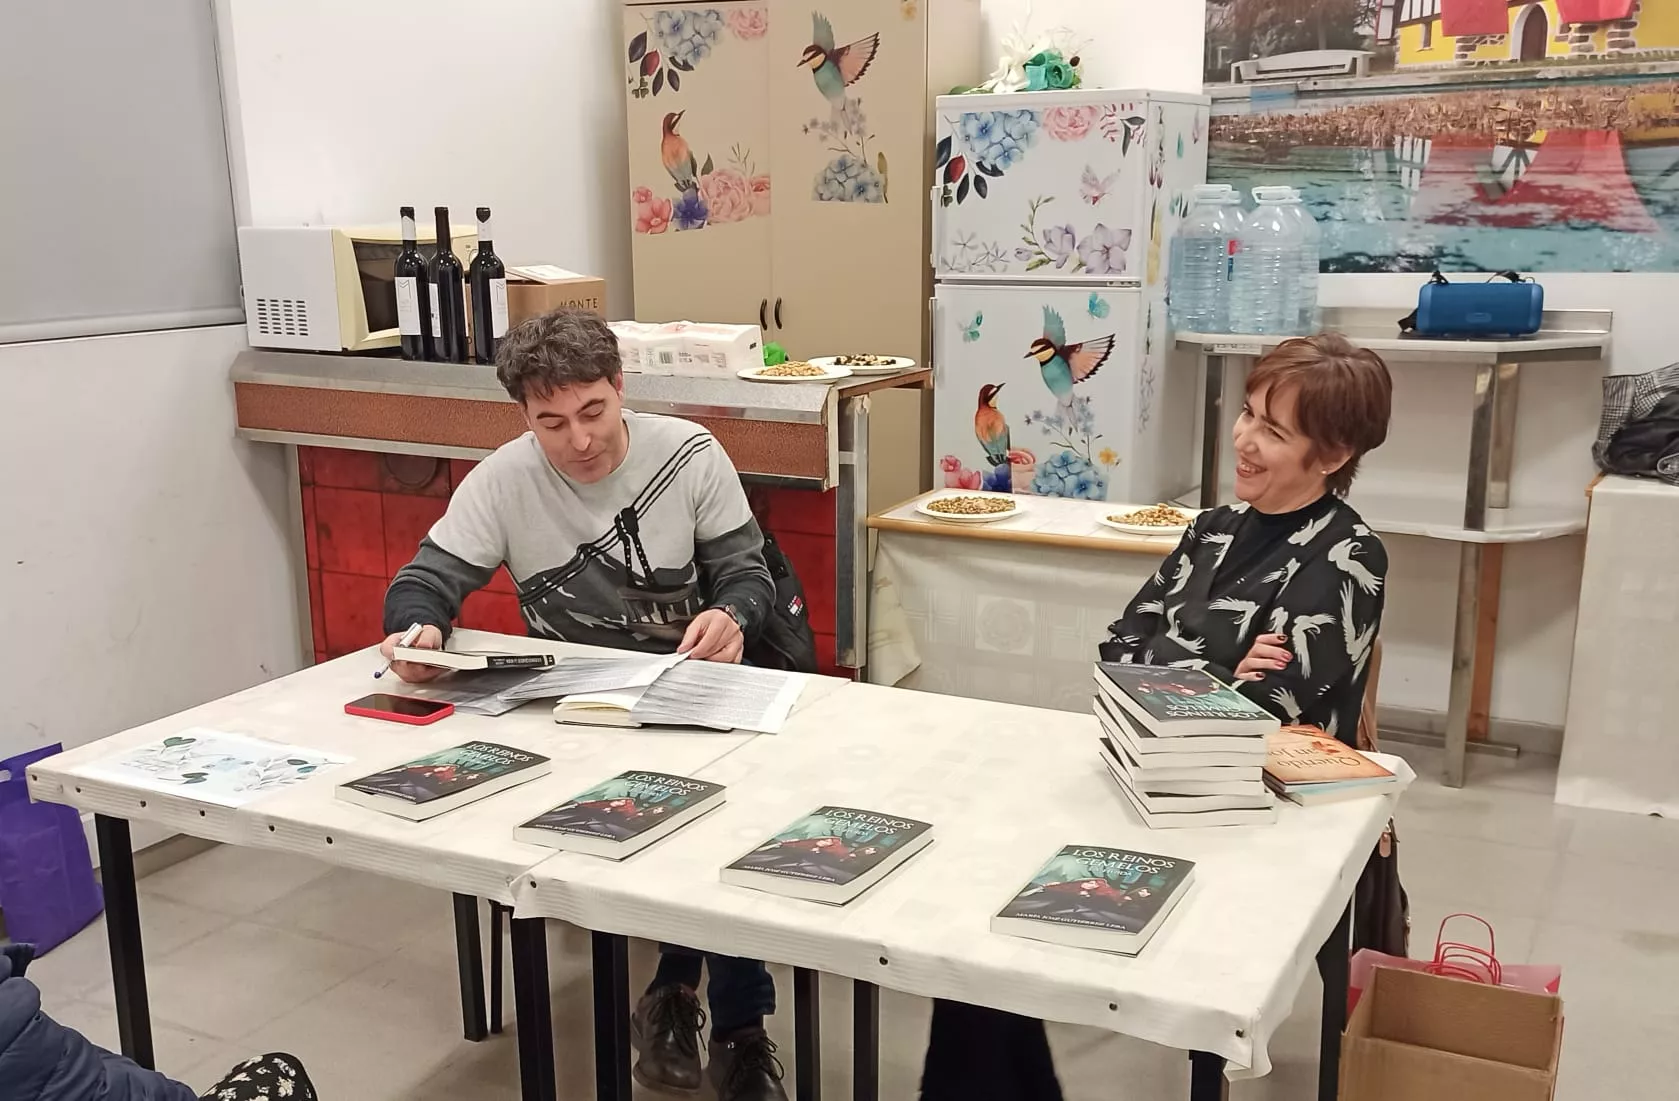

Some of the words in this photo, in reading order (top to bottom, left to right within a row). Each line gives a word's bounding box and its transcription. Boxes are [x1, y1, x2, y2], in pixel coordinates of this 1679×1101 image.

[460, 749, 515, 766] GEMELOS
[466, 743, 492, 752] LOS
[487, 747, 534, 763] REINOS
[1277, 756, 1360, 769] Querido
[624, 780, 691, 797] GEMELOS
[627, 773, 654, 782] LOS
[653, 776, 709, 792] REINOS
[824, 817, 898, 836] GEMELOS
[825, 809, 856, 819] LOS
[855, 813, 915, 830] REINOS
[1072, 849, 1106, 859] LOS
[1107, 852, 1176, 869] REINOS
[1075, 857, 1161, 875] GEMELOS
